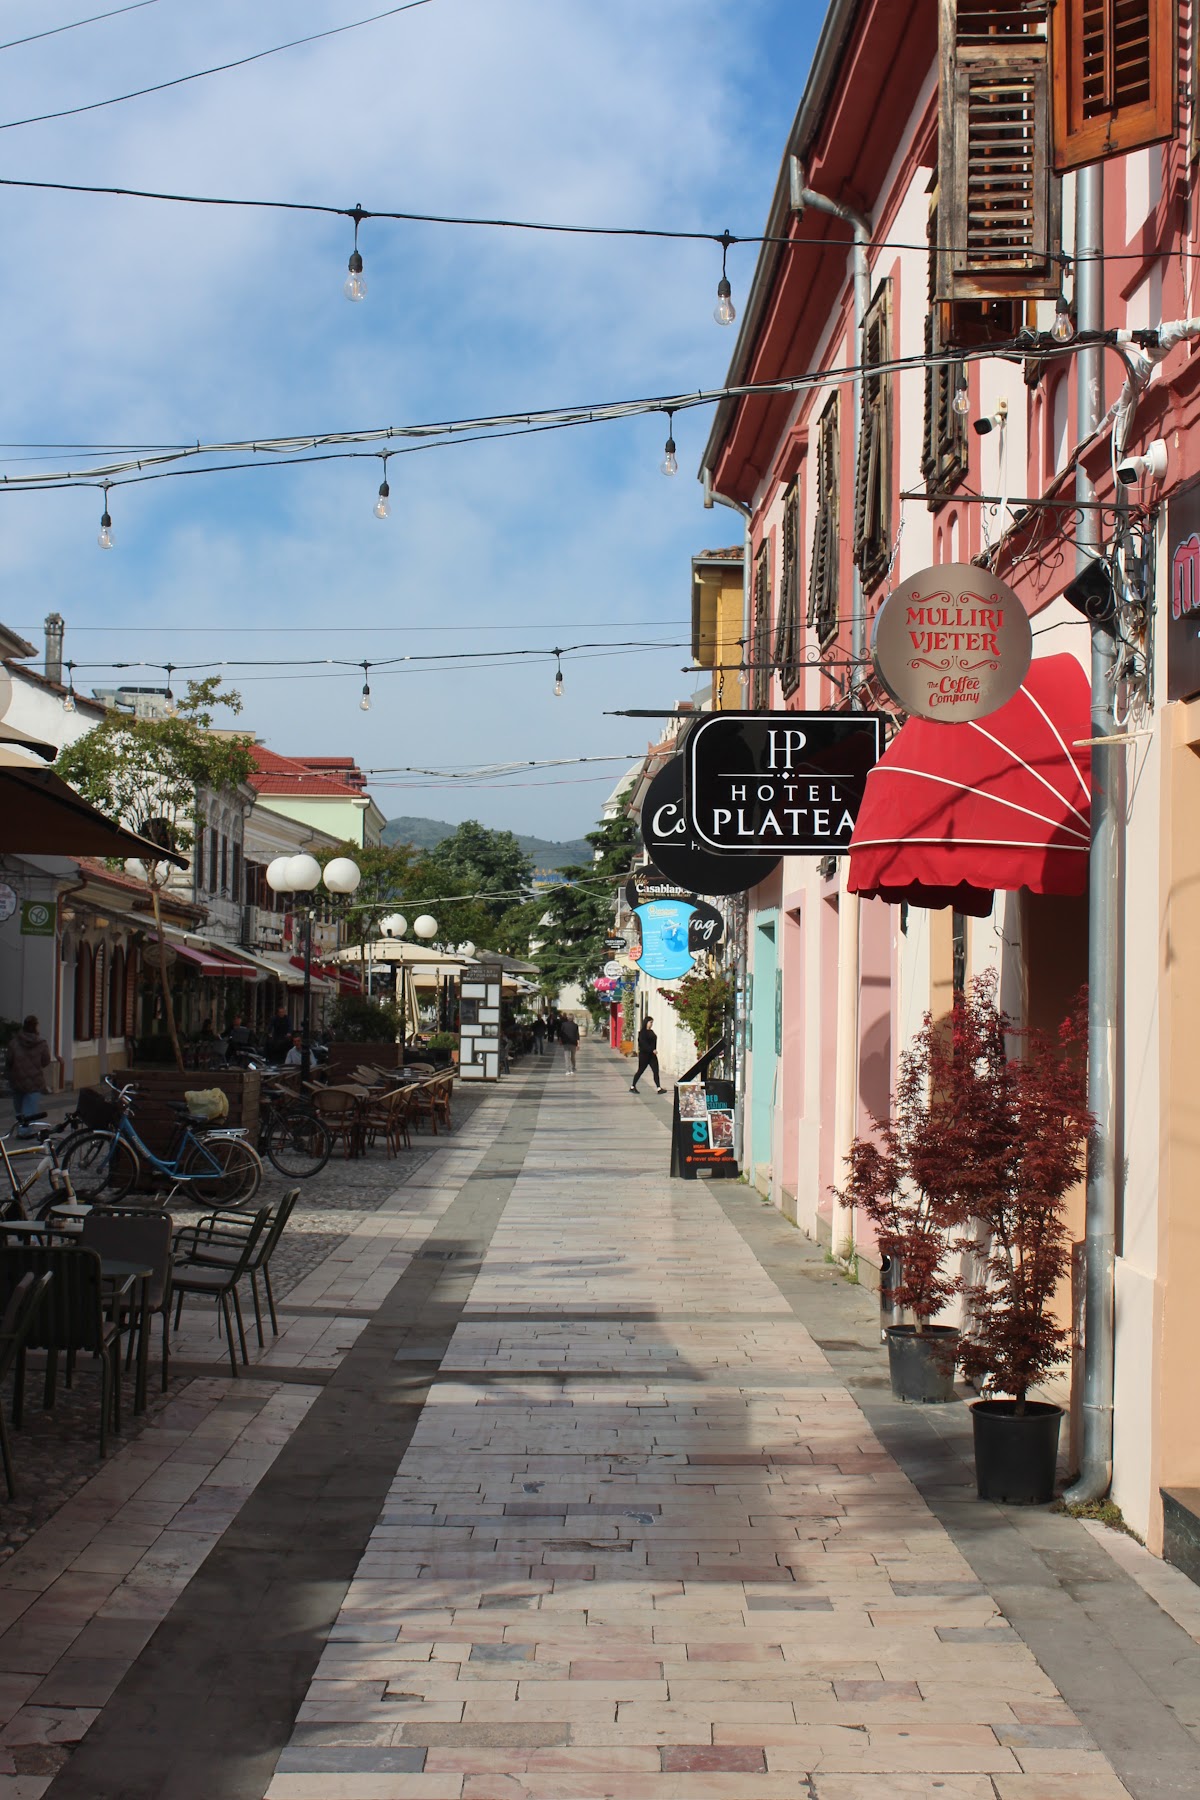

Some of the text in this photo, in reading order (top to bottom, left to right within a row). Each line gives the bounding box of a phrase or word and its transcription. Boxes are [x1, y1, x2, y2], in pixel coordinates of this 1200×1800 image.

[906, 607, 1004, 632] MULLIRI
[909, 631, 1001, 656] VJETER
[927, 676, 980, 694] The Coffee
[928, 692, 980, 707] Company
[767, 730, 807, 769] HP
[731, 784, 842, 802] HOTEL
[713, 808, 855, 836] PLATEA
[692, 1120, 708, 1142] 8
